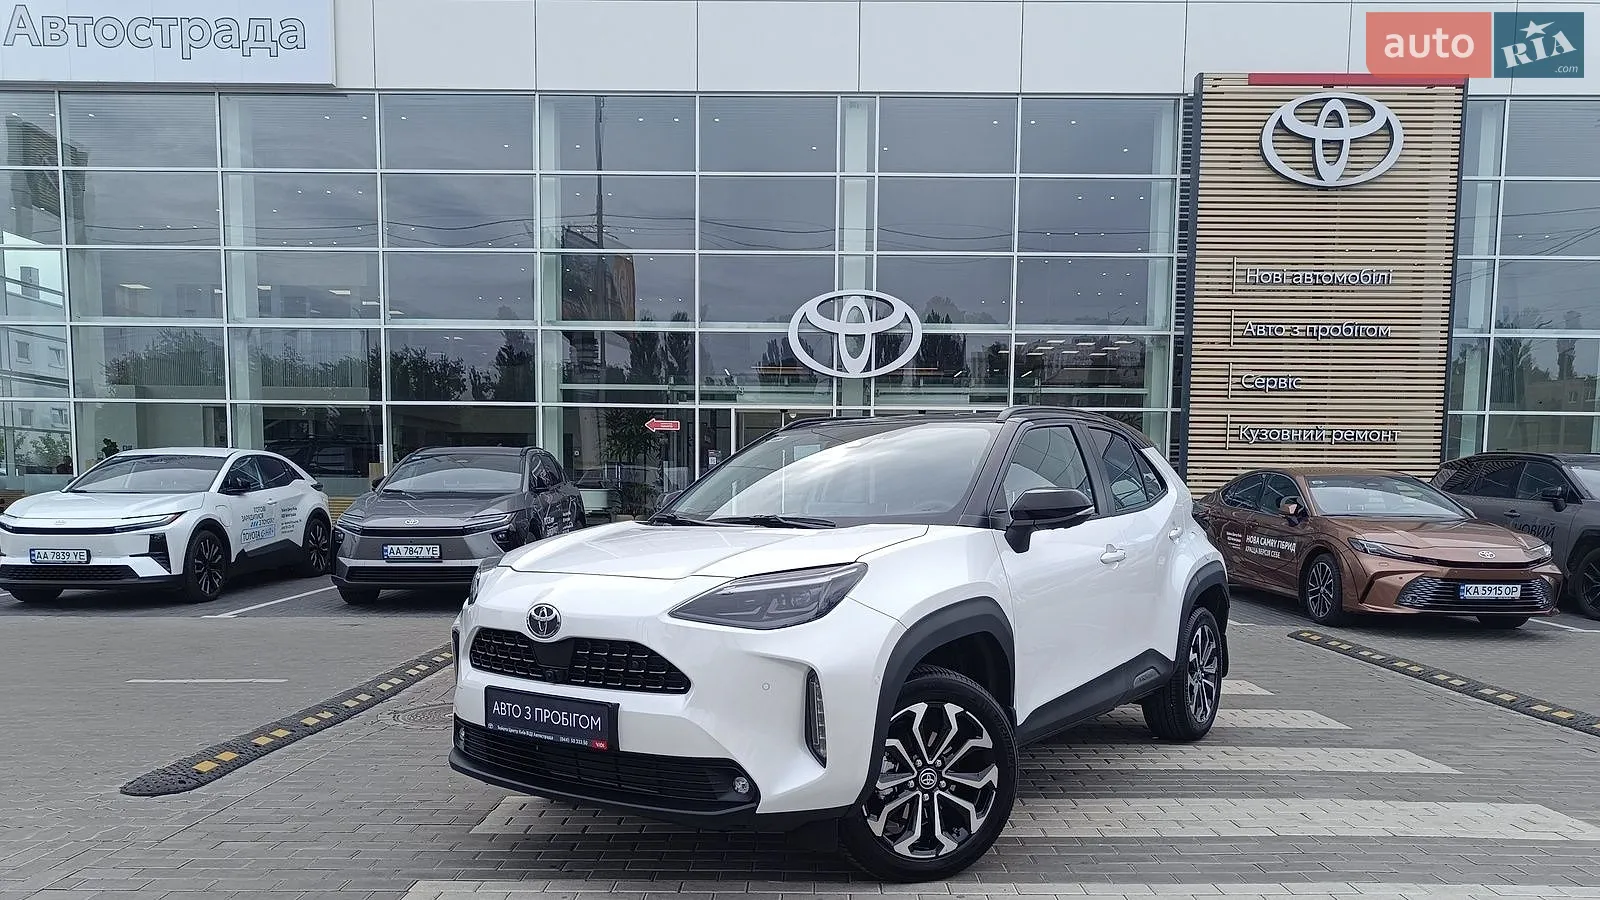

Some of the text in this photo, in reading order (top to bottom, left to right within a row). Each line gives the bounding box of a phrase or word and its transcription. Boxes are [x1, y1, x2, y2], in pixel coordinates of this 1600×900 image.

[3, 4, 306, 59] Автострада
[1245, 268, 1393, 285] Нові автомобілі
[1242, 321, 1391, 341] Авто з пробігом
[1241, 373, 1303, 393] Сервіс
[1238, 425, 1400, 445] Кузовний ремонт
[1246, 534, 1259, 545] НОВА
[50, 551, 71, 560] 7839
[73, 551, 85, 560] YE
[403, 546, 424, 556] 7847
[425, 546, 438, 556] YE
[1465, 586, 1480, 596] KA
[1481, 586, 1503, 596] 5915
[492, 701, 521, 718] АВТО
[534, 707, 601, 732] ПРОБІГОМ
